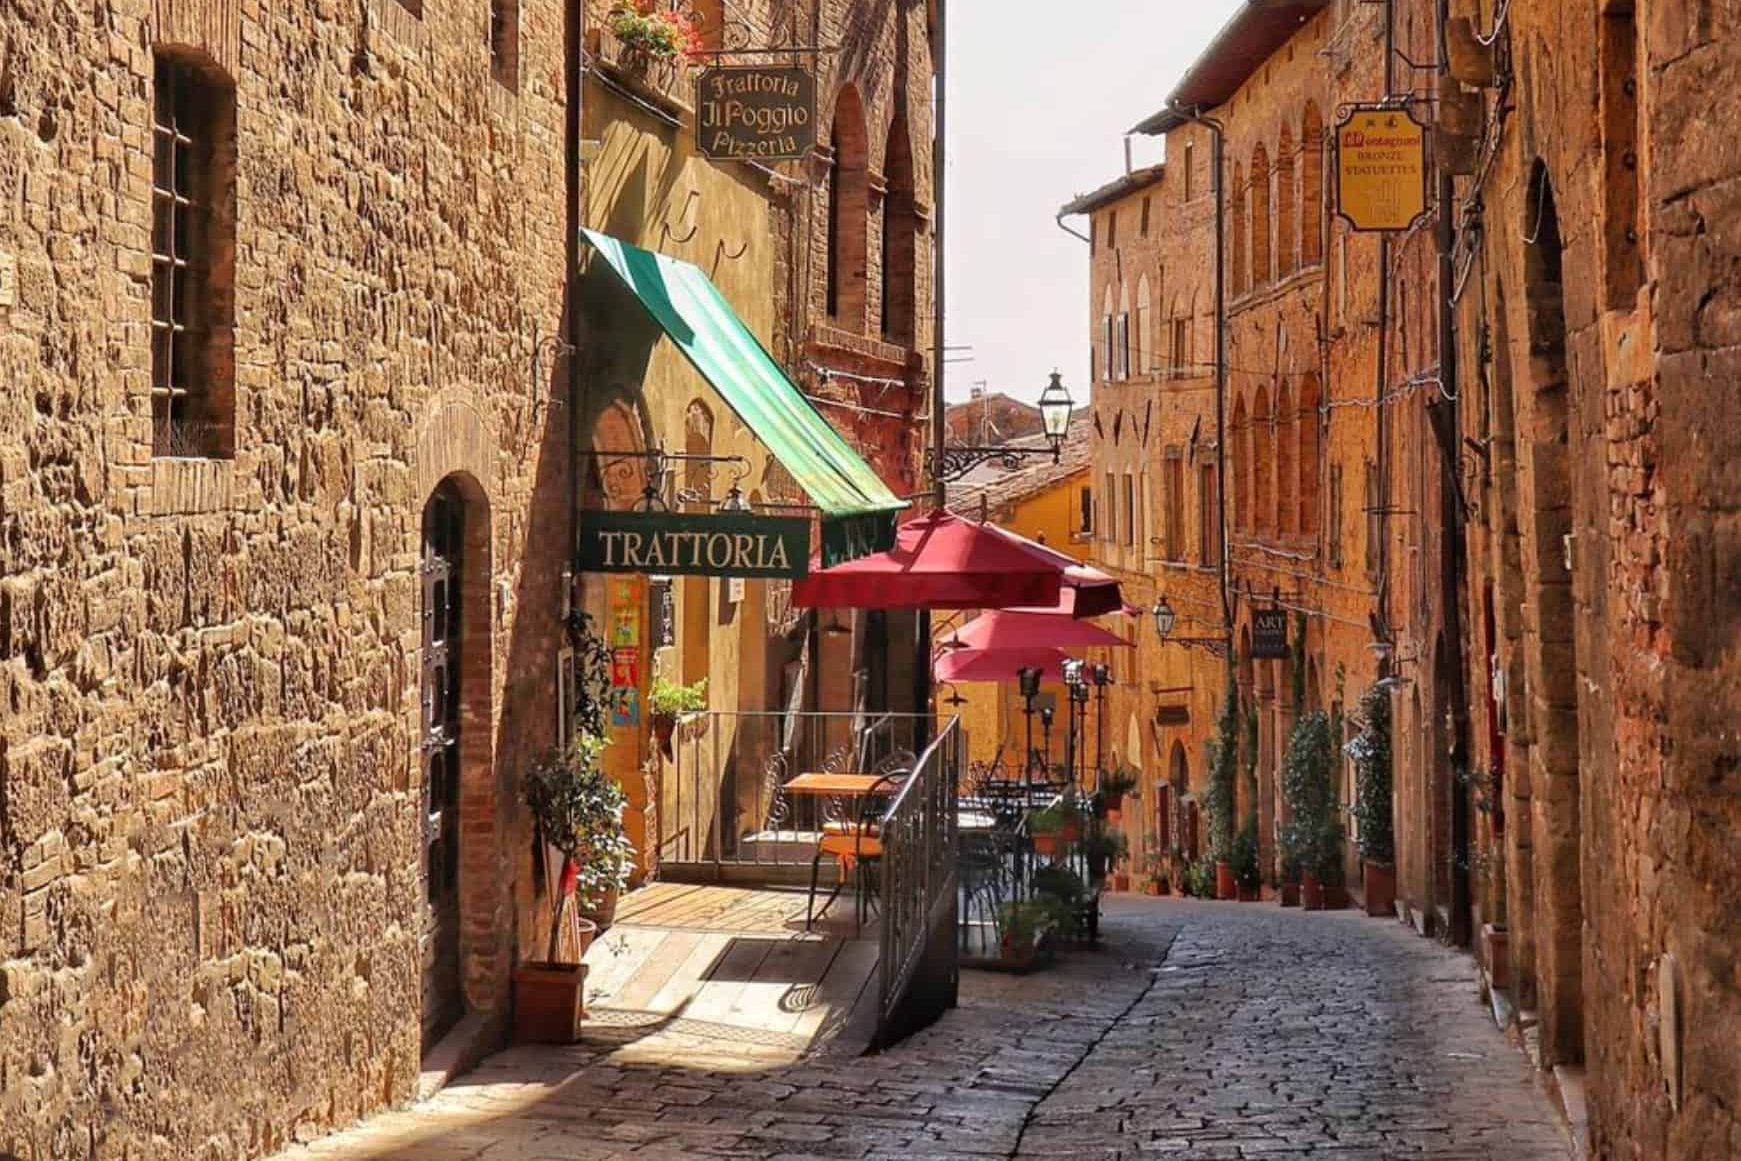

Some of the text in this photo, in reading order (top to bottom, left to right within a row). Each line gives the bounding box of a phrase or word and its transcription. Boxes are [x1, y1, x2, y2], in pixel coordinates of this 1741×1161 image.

[710, 73, 799, 99] Trattoria
[725, 101, 808, 134] Poggio
[712, 130, 796, 157] Pizzeria
[599, 530, 792, 569] TRATTORIA
[1255, 615, 1284, 629] ART
